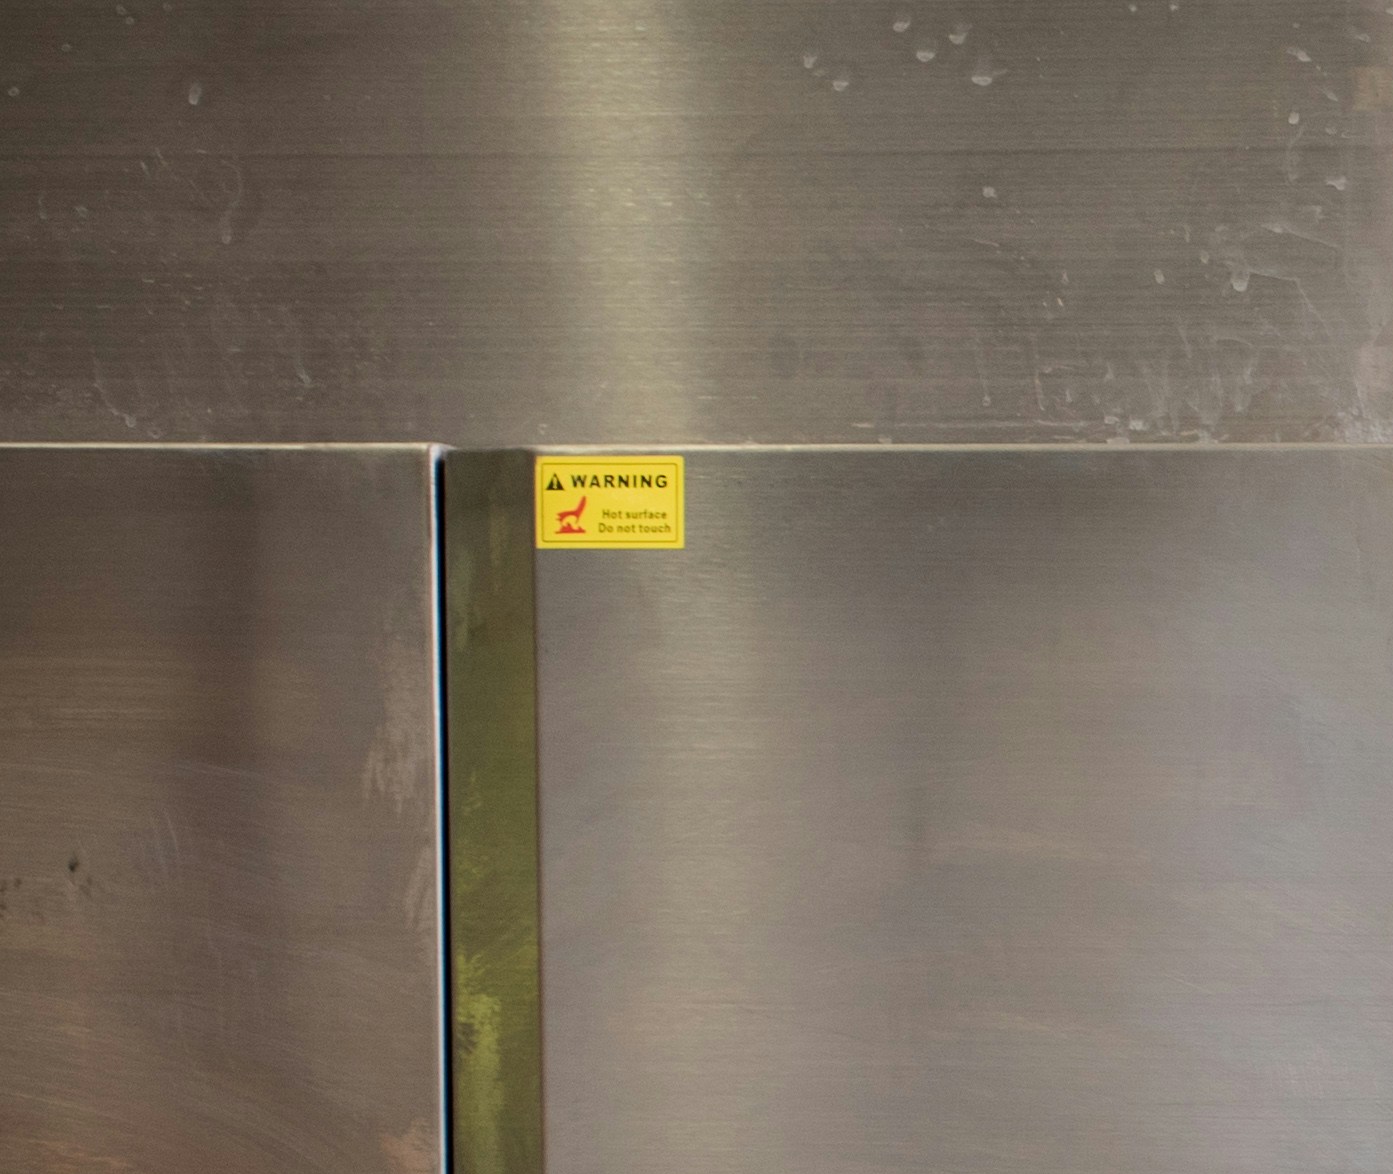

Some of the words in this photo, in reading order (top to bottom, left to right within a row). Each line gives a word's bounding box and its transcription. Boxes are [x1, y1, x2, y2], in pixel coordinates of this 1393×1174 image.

[570, 474, 668, 488] WARNING
[601, 509, 622, 519] Hot
[625, 509, 668, 520] surface
[597, 523, 614, 533] Do
[616, 523, 636, 533] not
[638, 523, 671, 534] touch
